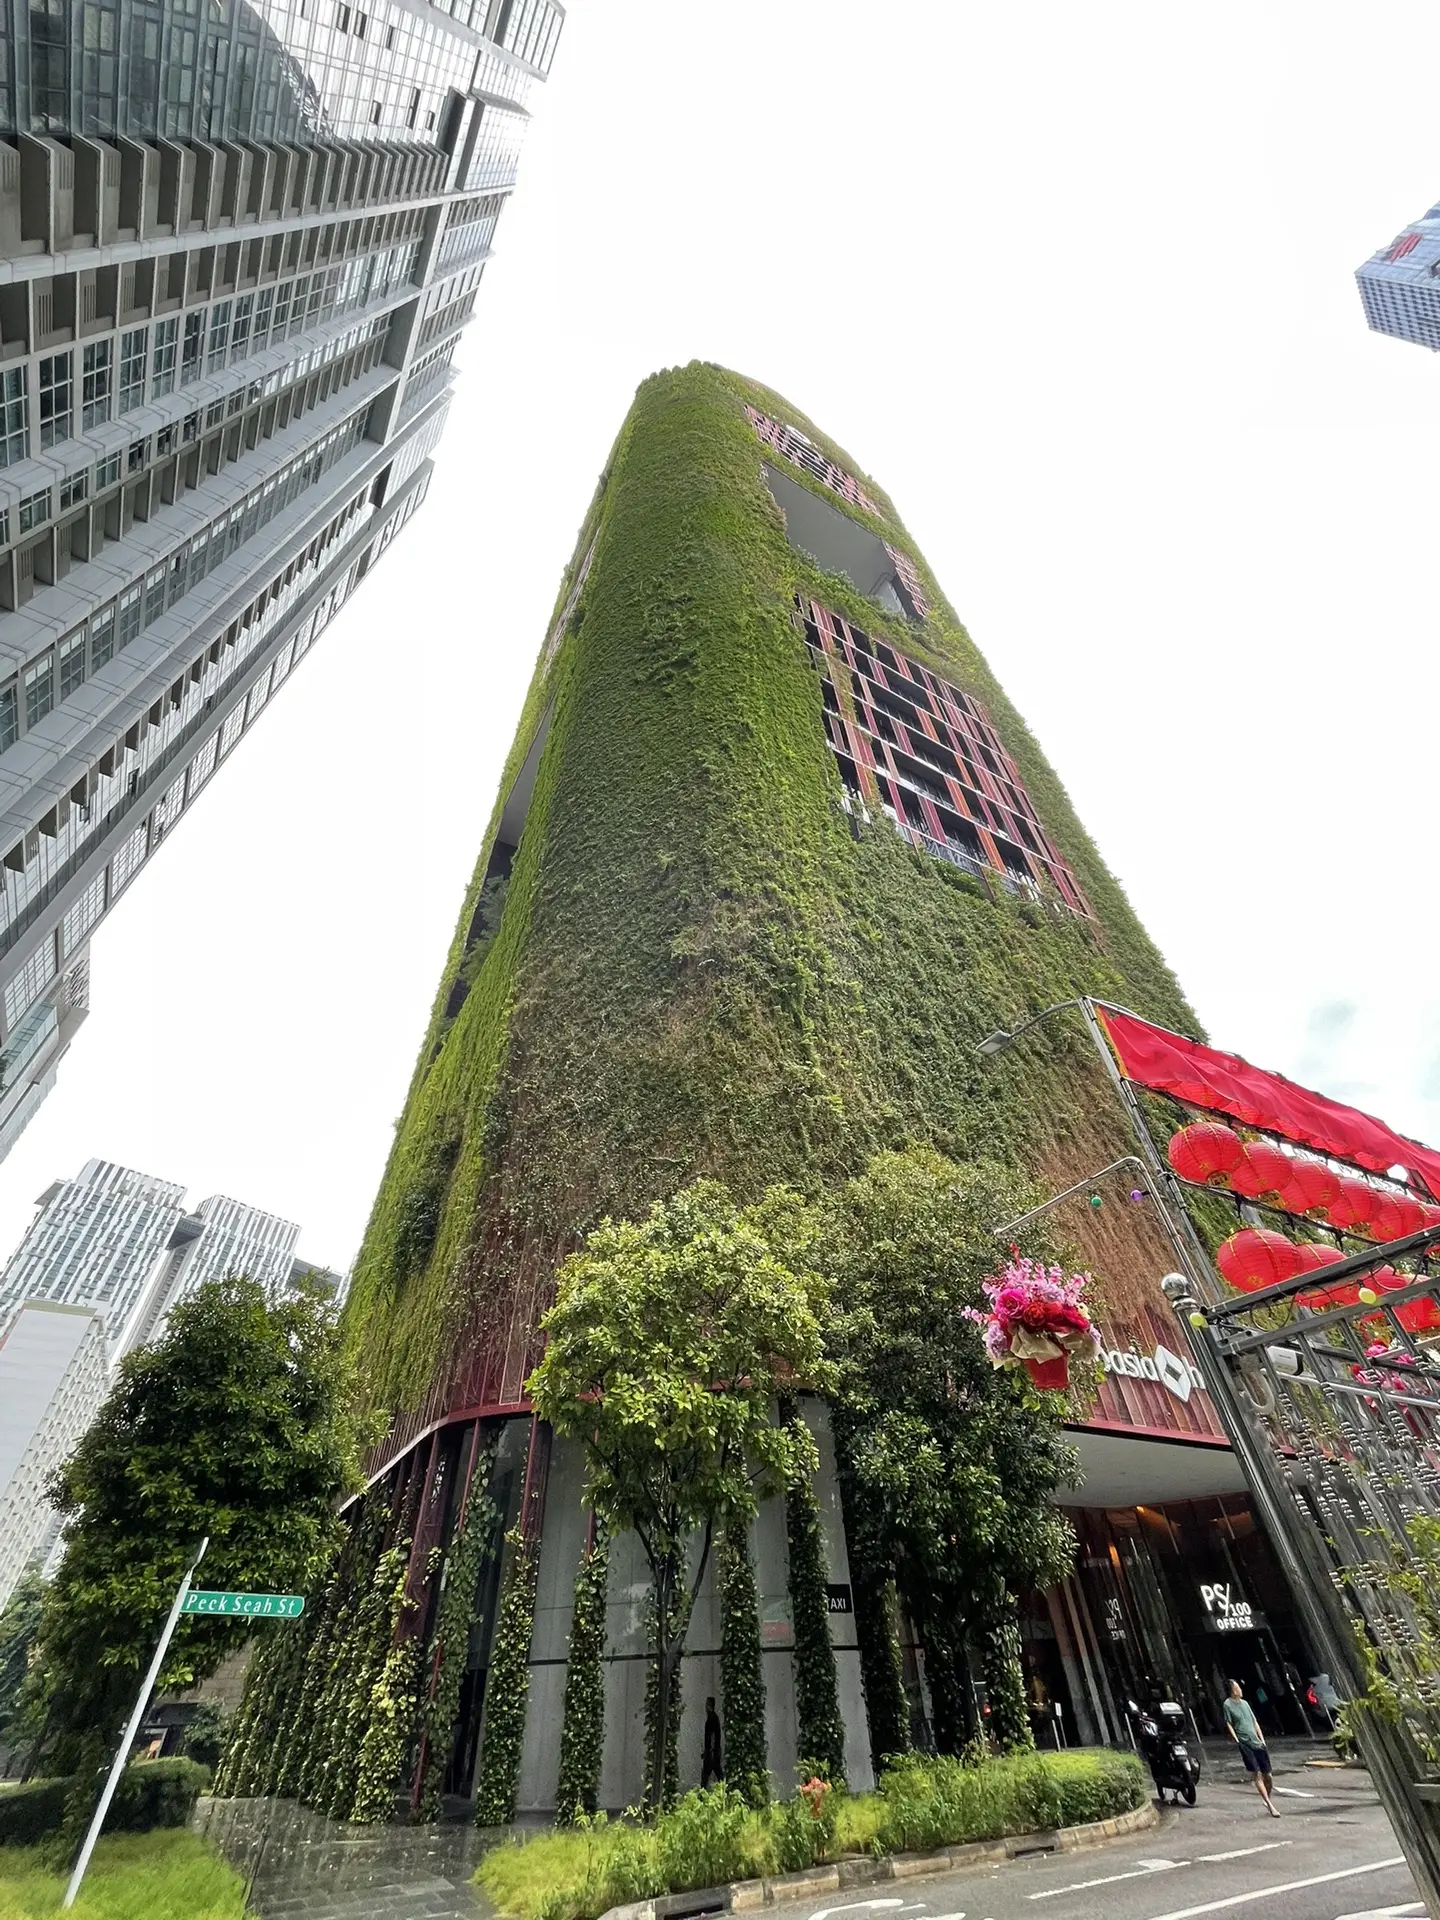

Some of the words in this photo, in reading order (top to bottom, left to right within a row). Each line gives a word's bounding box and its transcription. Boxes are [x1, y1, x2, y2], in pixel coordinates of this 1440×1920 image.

[186, 1594, 228, 1610] Peck
[232, 1596, 272, 1613] Seah
[277, 1598, 295, 1614] St
[1216, 1616, 1254, 1630] OFFICE
